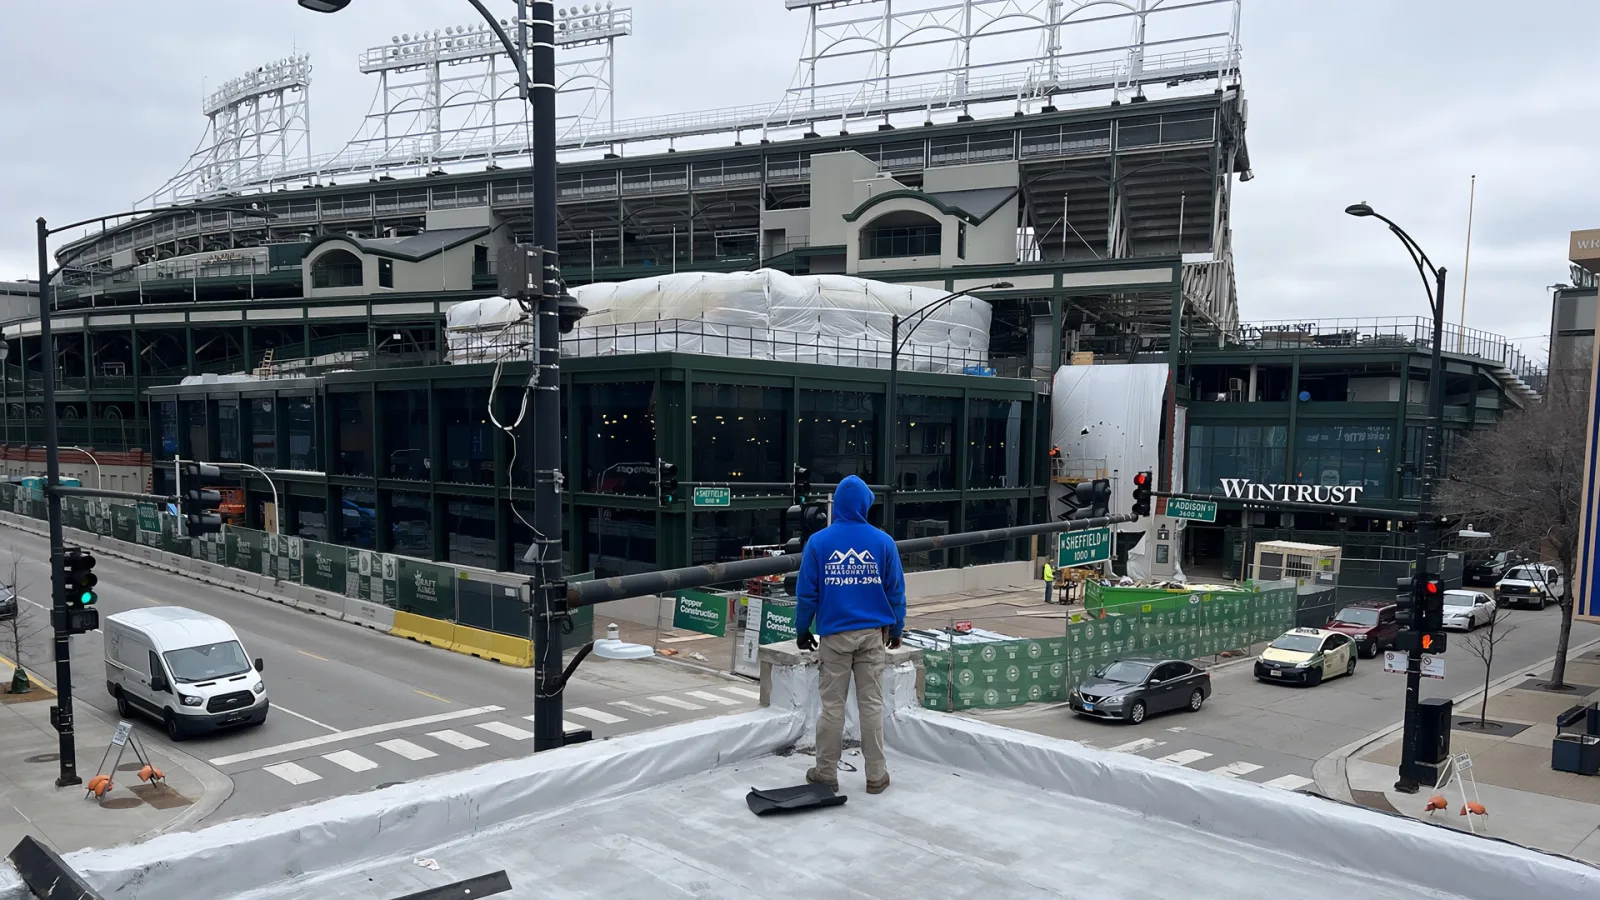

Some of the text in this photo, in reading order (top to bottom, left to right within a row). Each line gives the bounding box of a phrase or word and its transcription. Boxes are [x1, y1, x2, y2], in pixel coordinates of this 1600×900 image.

[699, 490, 724, 498] SHEFFIELD
[1220, 478, 1363, 504] WINTRUST
[1175, 501, 1206, 512] ADDISON
[1179, 510, 1196, 518] 3600
[1061, 540, 1066, 549] N
[1065, 532, 1101, 550] SHEFFIELD
[1074, 549, 1096, 561] 1000 W
[680, 596, 703, 608] Pepper
[680, 605, 719, 619] Construction
[766, 611, 791, 624] Pepper
